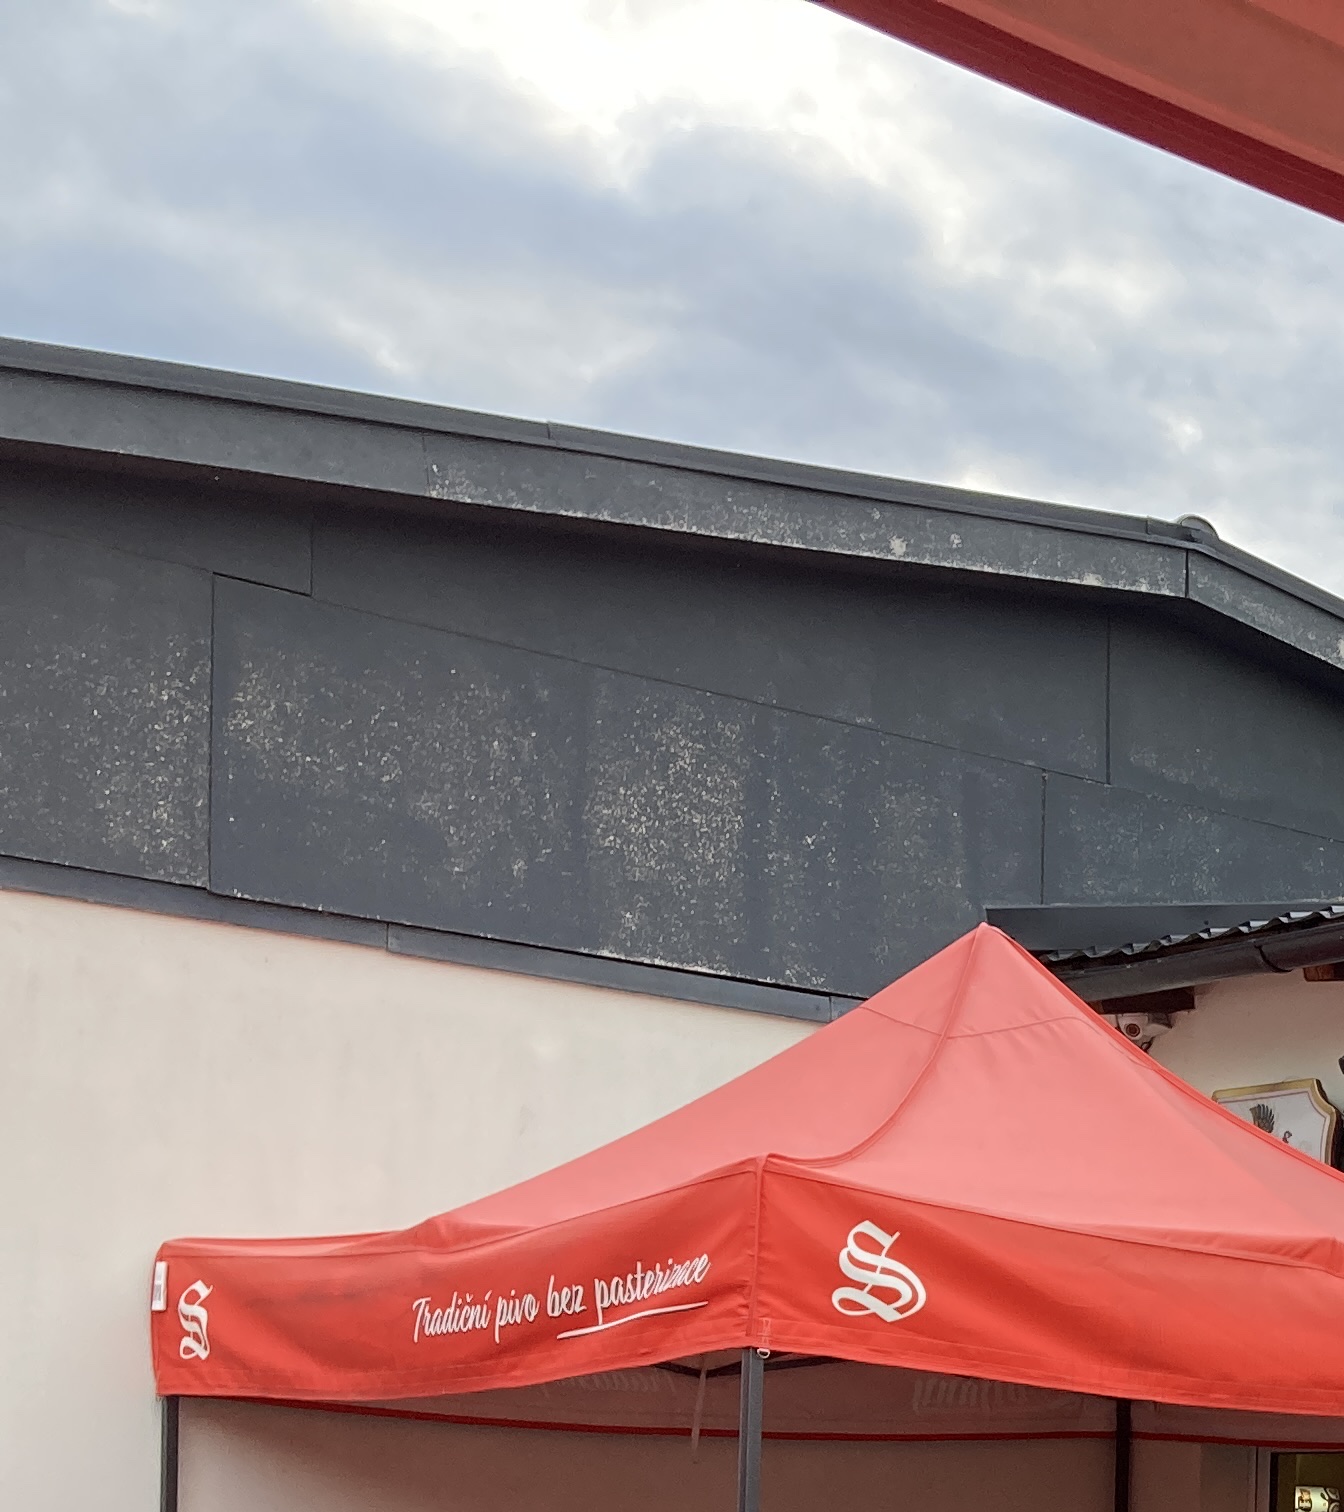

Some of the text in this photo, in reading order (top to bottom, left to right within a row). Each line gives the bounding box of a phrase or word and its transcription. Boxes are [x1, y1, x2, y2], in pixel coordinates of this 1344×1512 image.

[412, 1253, 712, 1343] Tradiční pivo bez pasterizace
